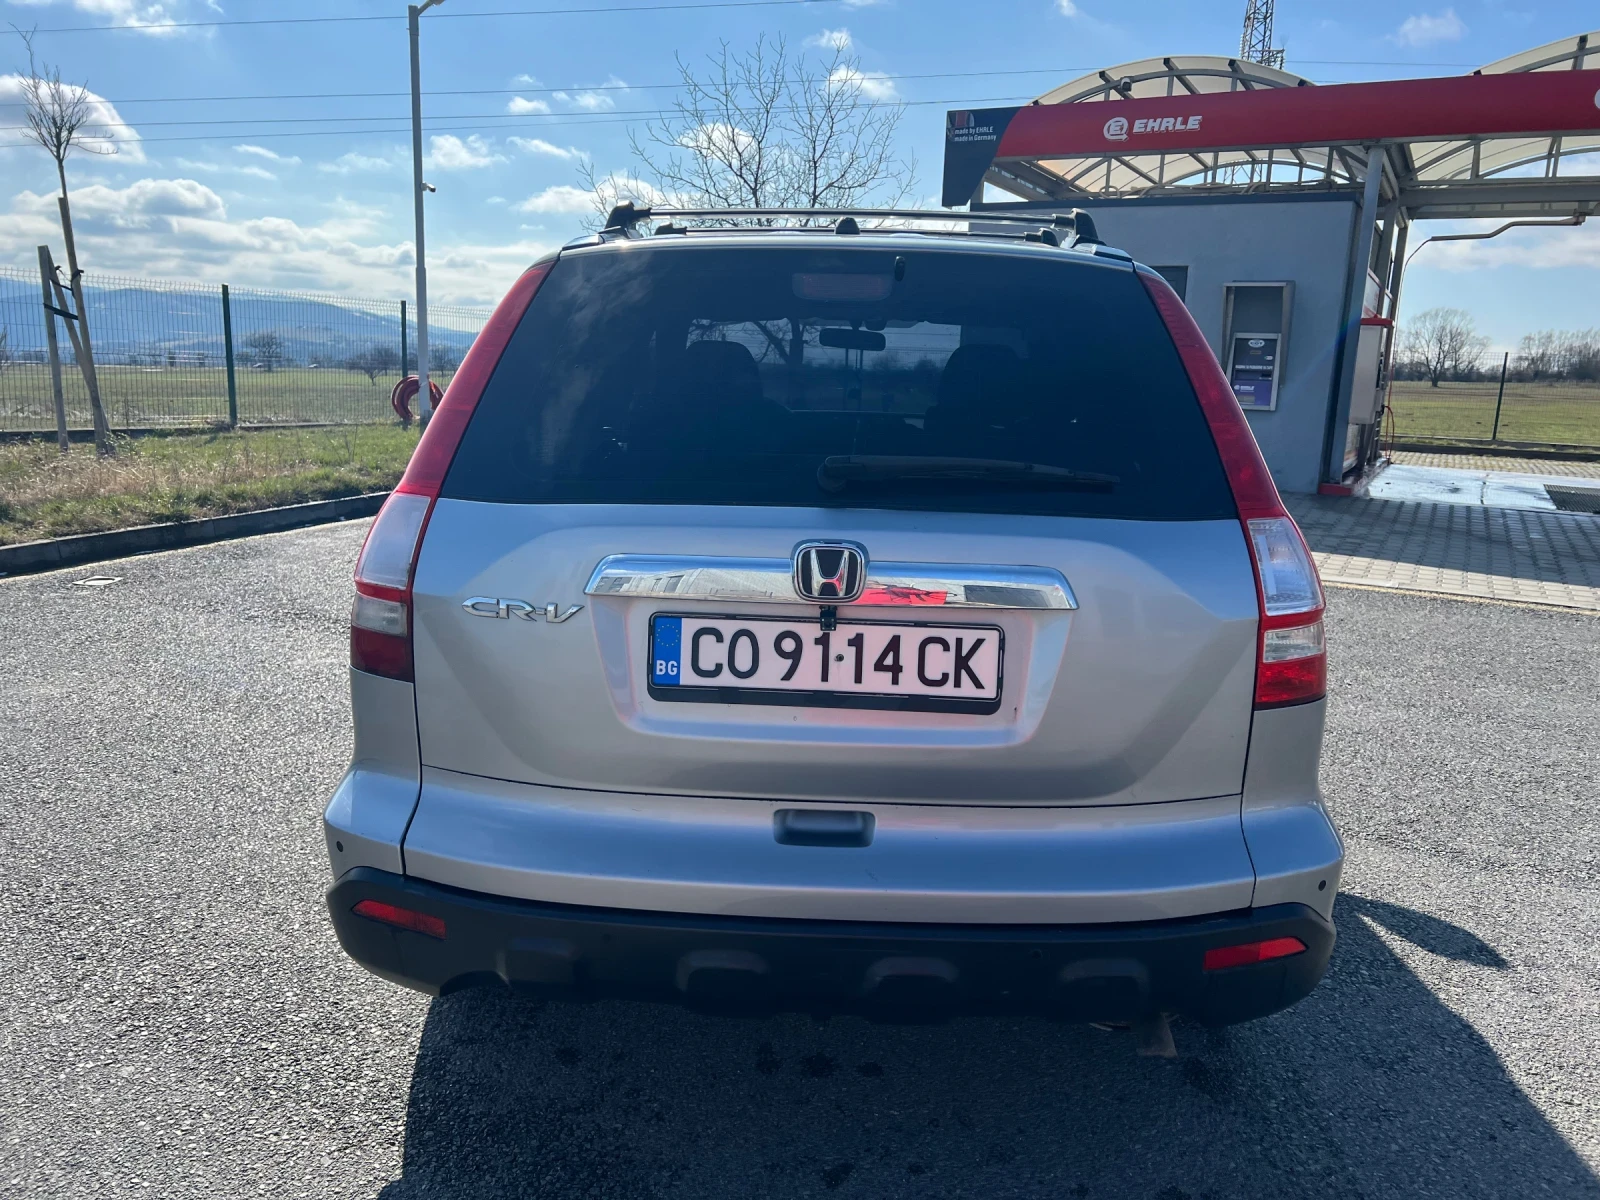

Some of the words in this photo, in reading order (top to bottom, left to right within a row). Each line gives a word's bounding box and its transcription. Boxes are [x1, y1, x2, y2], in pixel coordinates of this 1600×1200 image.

[1133, 116, 1202, 134] EHRLE
[462, 596, 584, 623] CR-V
[656, 660, 678, 676] BG
[691, 627, 760, 679] CO
[773, 630, 903, 686] 9114
[917, 636, 986, 690] CK
